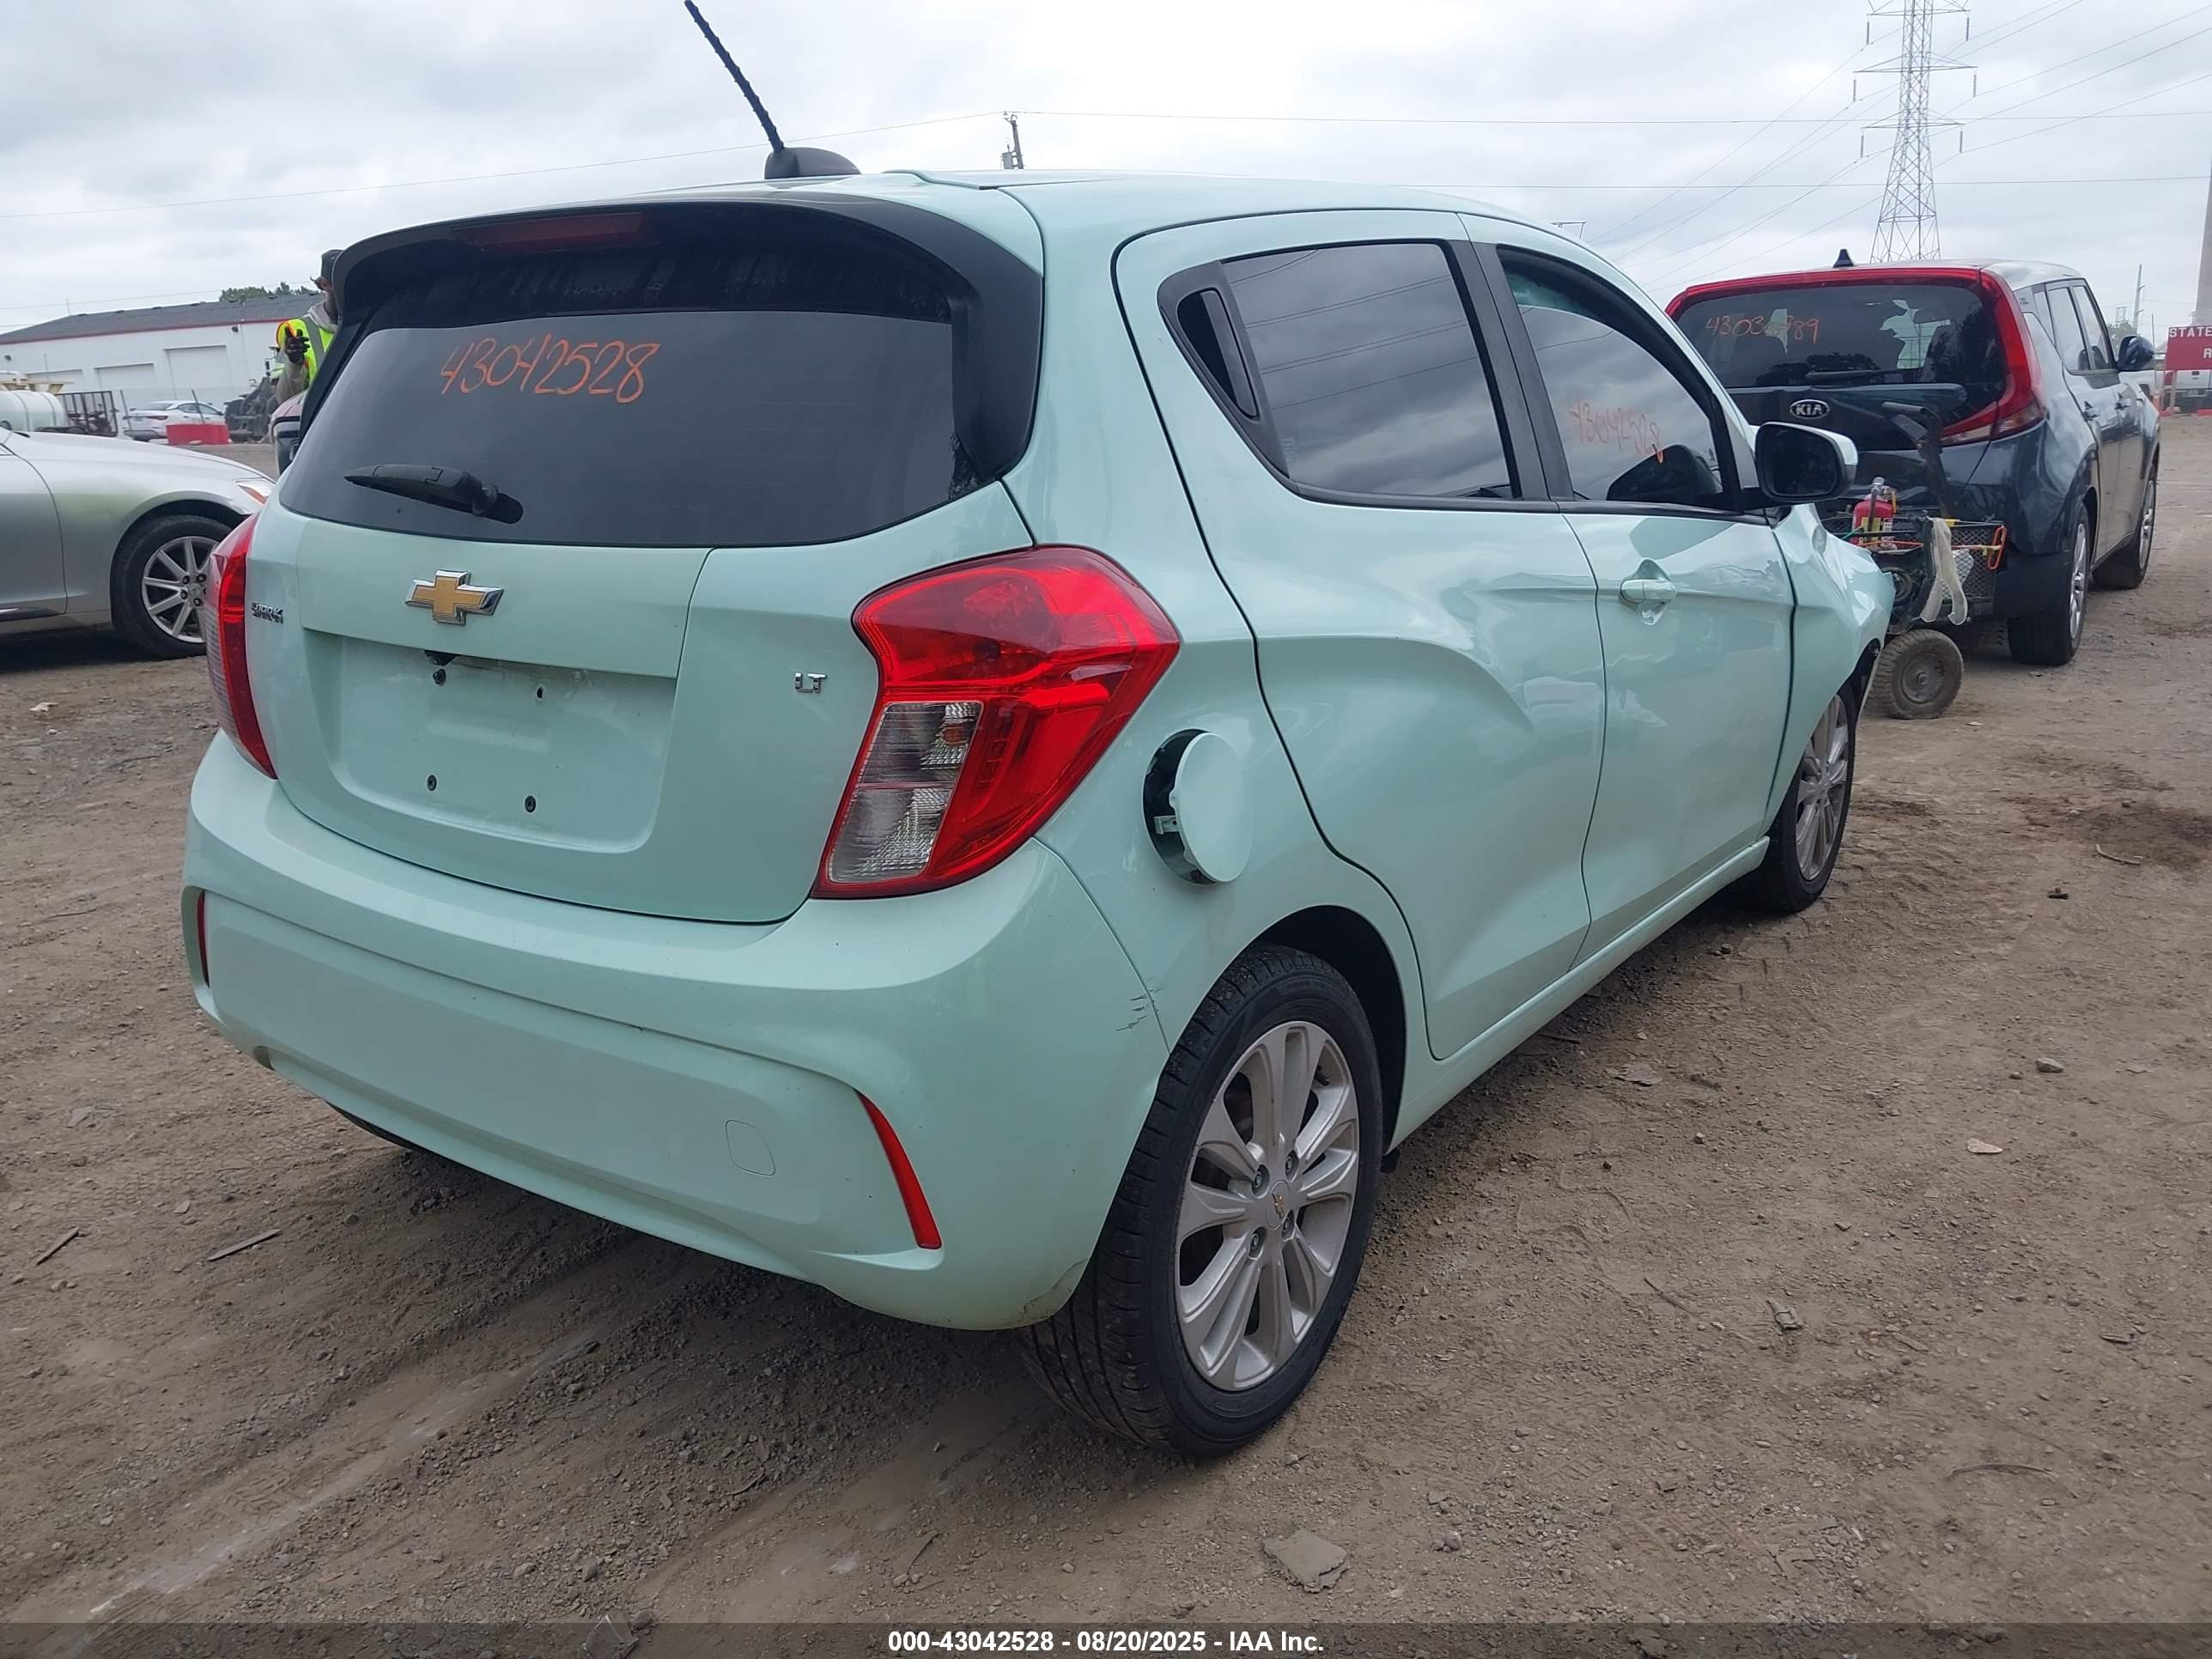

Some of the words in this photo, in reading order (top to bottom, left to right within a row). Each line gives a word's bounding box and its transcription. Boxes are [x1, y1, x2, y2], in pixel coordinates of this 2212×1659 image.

[440, 333, 660, 403] 43042528
[1796, 404, 1823, 416] KIA
[794, 672, 827, 694] LT
